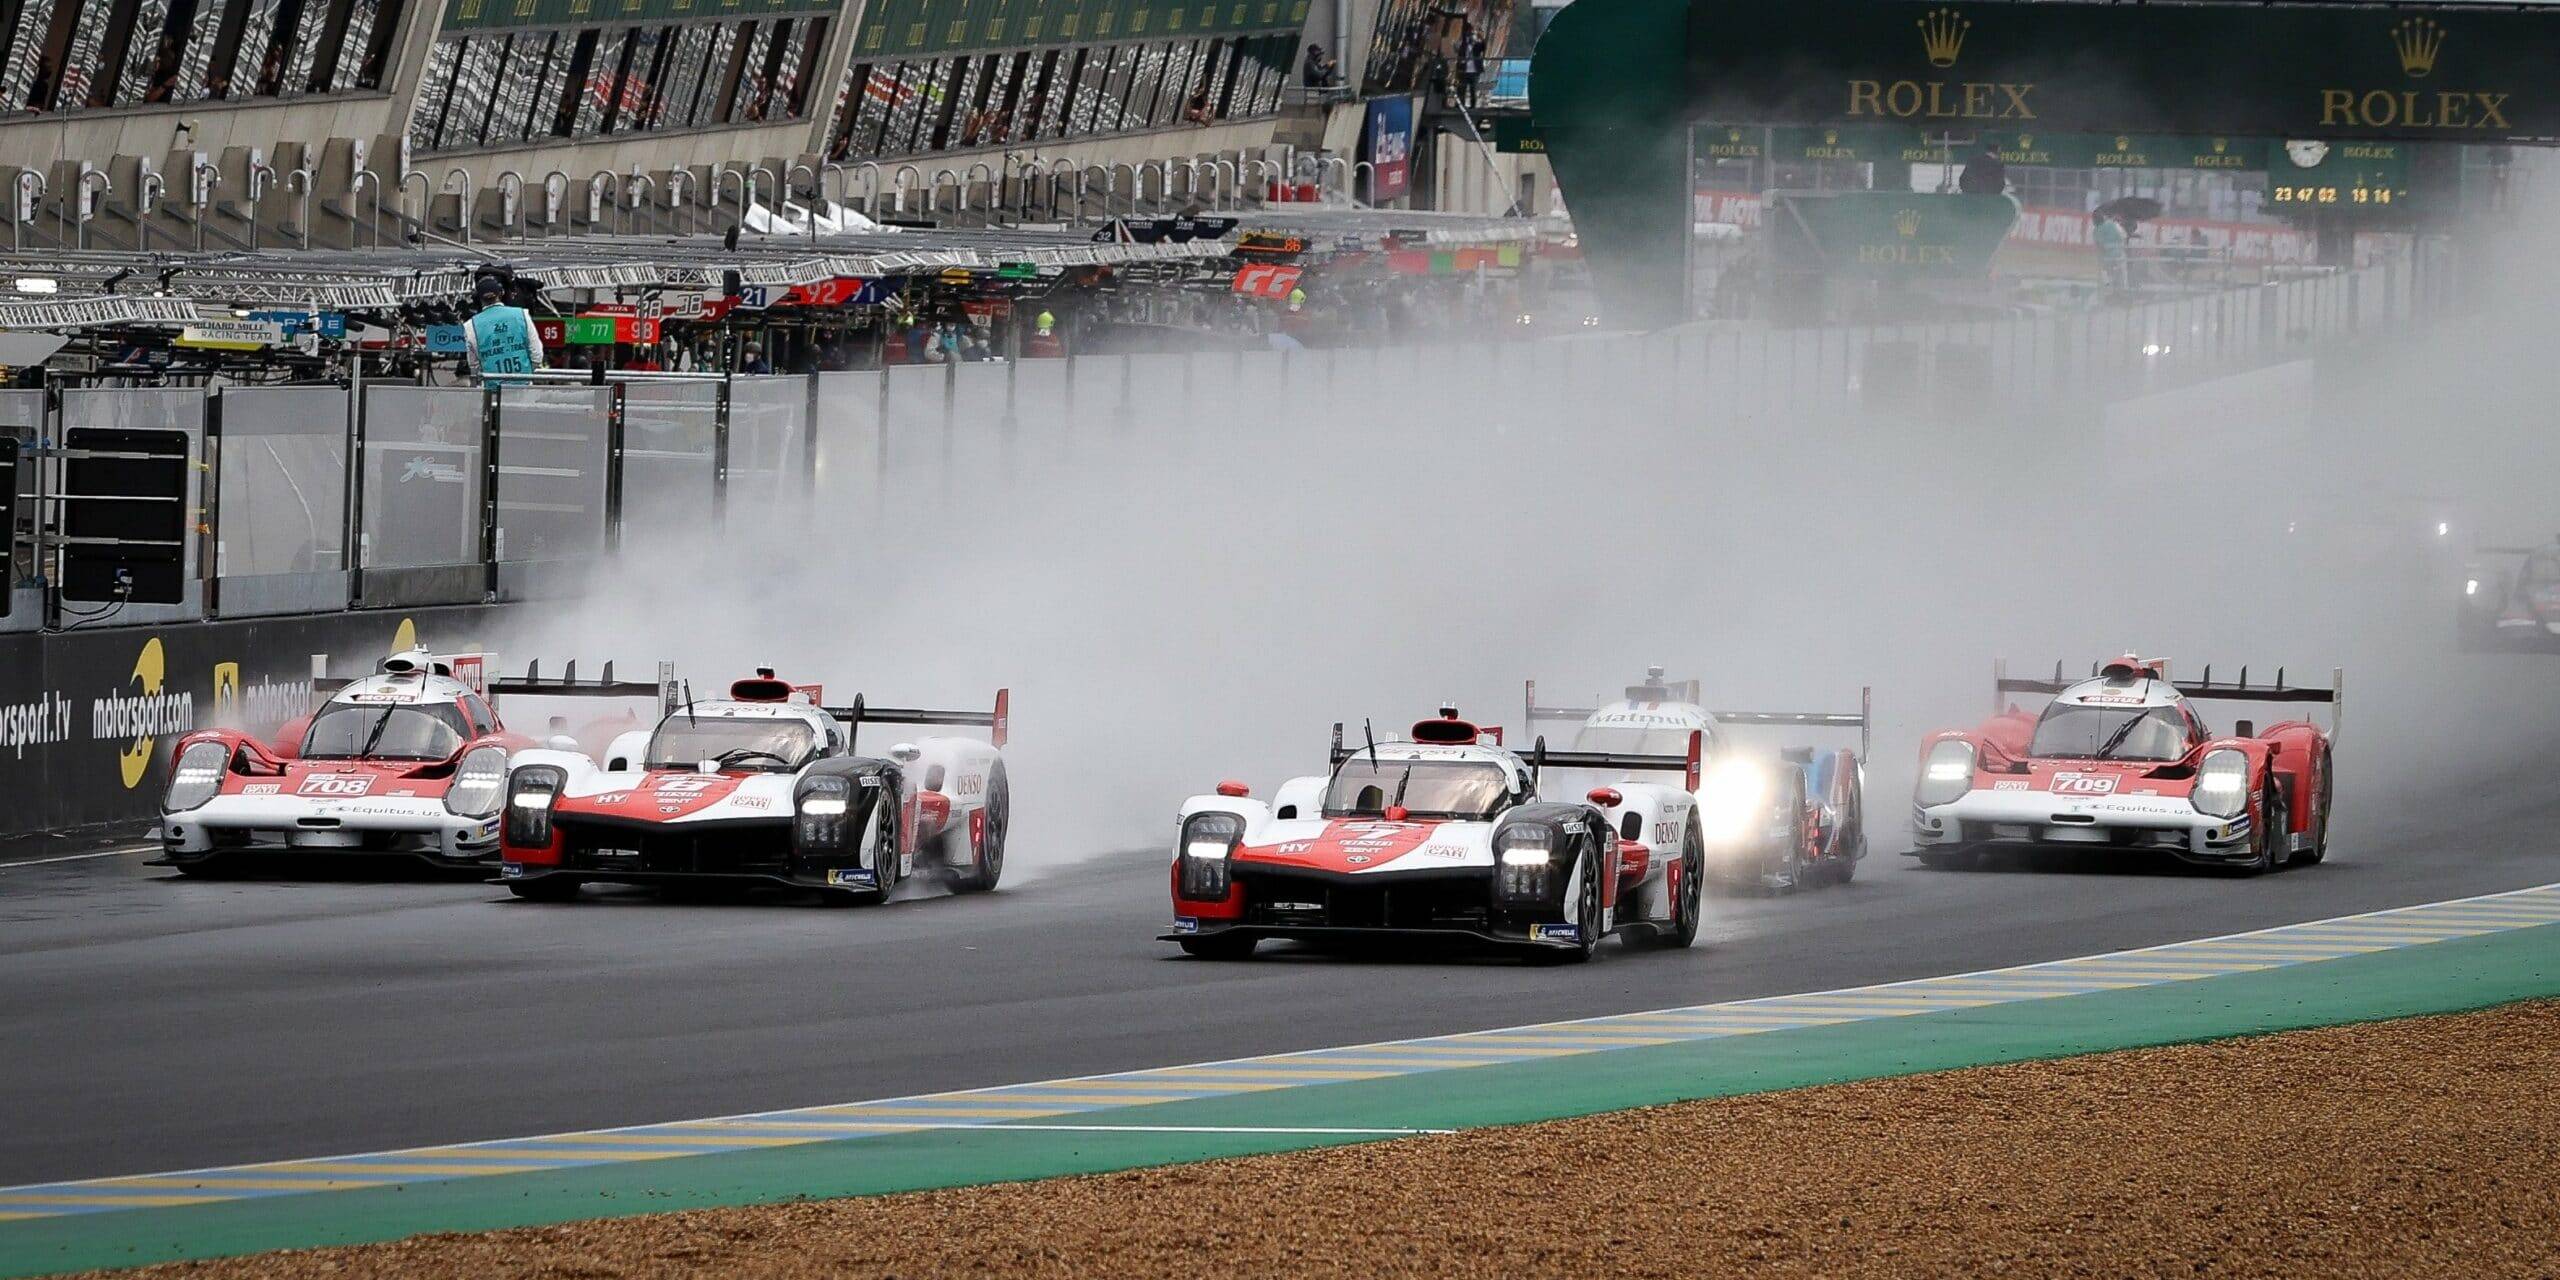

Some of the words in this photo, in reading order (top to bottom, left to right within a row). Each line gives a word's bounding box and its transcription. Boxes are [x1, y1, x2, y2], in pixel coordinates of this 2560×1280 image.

[1846, 80, 2037, 120] ROLEX
[2319, 89, 2511, 129] ROLEX
[1710, 144, 1759, 156] ROLEX
[1806, 146, 1856, 159] ROLEX
[2343, 146, 2394, 159] ROLEX
[2001, 151, 2050, 163] ROLEX
[2096, 153, 2146, 165] ROLEX
[2194, 155, 2244, 167] ROLEX
[2274, 187, 2293, 202] 23
[2296, 187, 2315, 202] 47
[1097, 231, 1111, 241] 32
[1859, 245, 1953, 264] ROLEX
[743, 287, 761, 305] 21
[806, 280, 837, 303] 92
[201, 331, 240, 340] RACING
[243, 331, 272, 341] TEAM
[544, 326, 558, 340] 95
[590, 323, 609, 337] 777
[631, 320, 653, 340] 98
[495, 356, 521, 374] 105
[246, 674, 311, 722] motorspor
[357, 694, 415, 702] MOTUL
[2087, 695, 2142, 704] MOTUL
[0, 690, 71, 760] rsport.tv
[93, 685, 193, 757] motorsport.com
[303, 780, 368, 793] 708
[657, 780, 713, 791] 8
[957, 774, 982, 795] DENSO
[2056, 779, 2114, 792] 709
[599, 794, 626, 804] HY
[735, 799, 766, 808] CAR
[352, 806, 441, 818] Equitus.us
[2106, 804, 2193, 816] Equitus.us
[1350, 829, 1402, 840] 7
[1655, 821, 1679, 845] DENSO
[1280, 842, 1310, 853] HY
[1429, 848, 1463, 858] CAR
